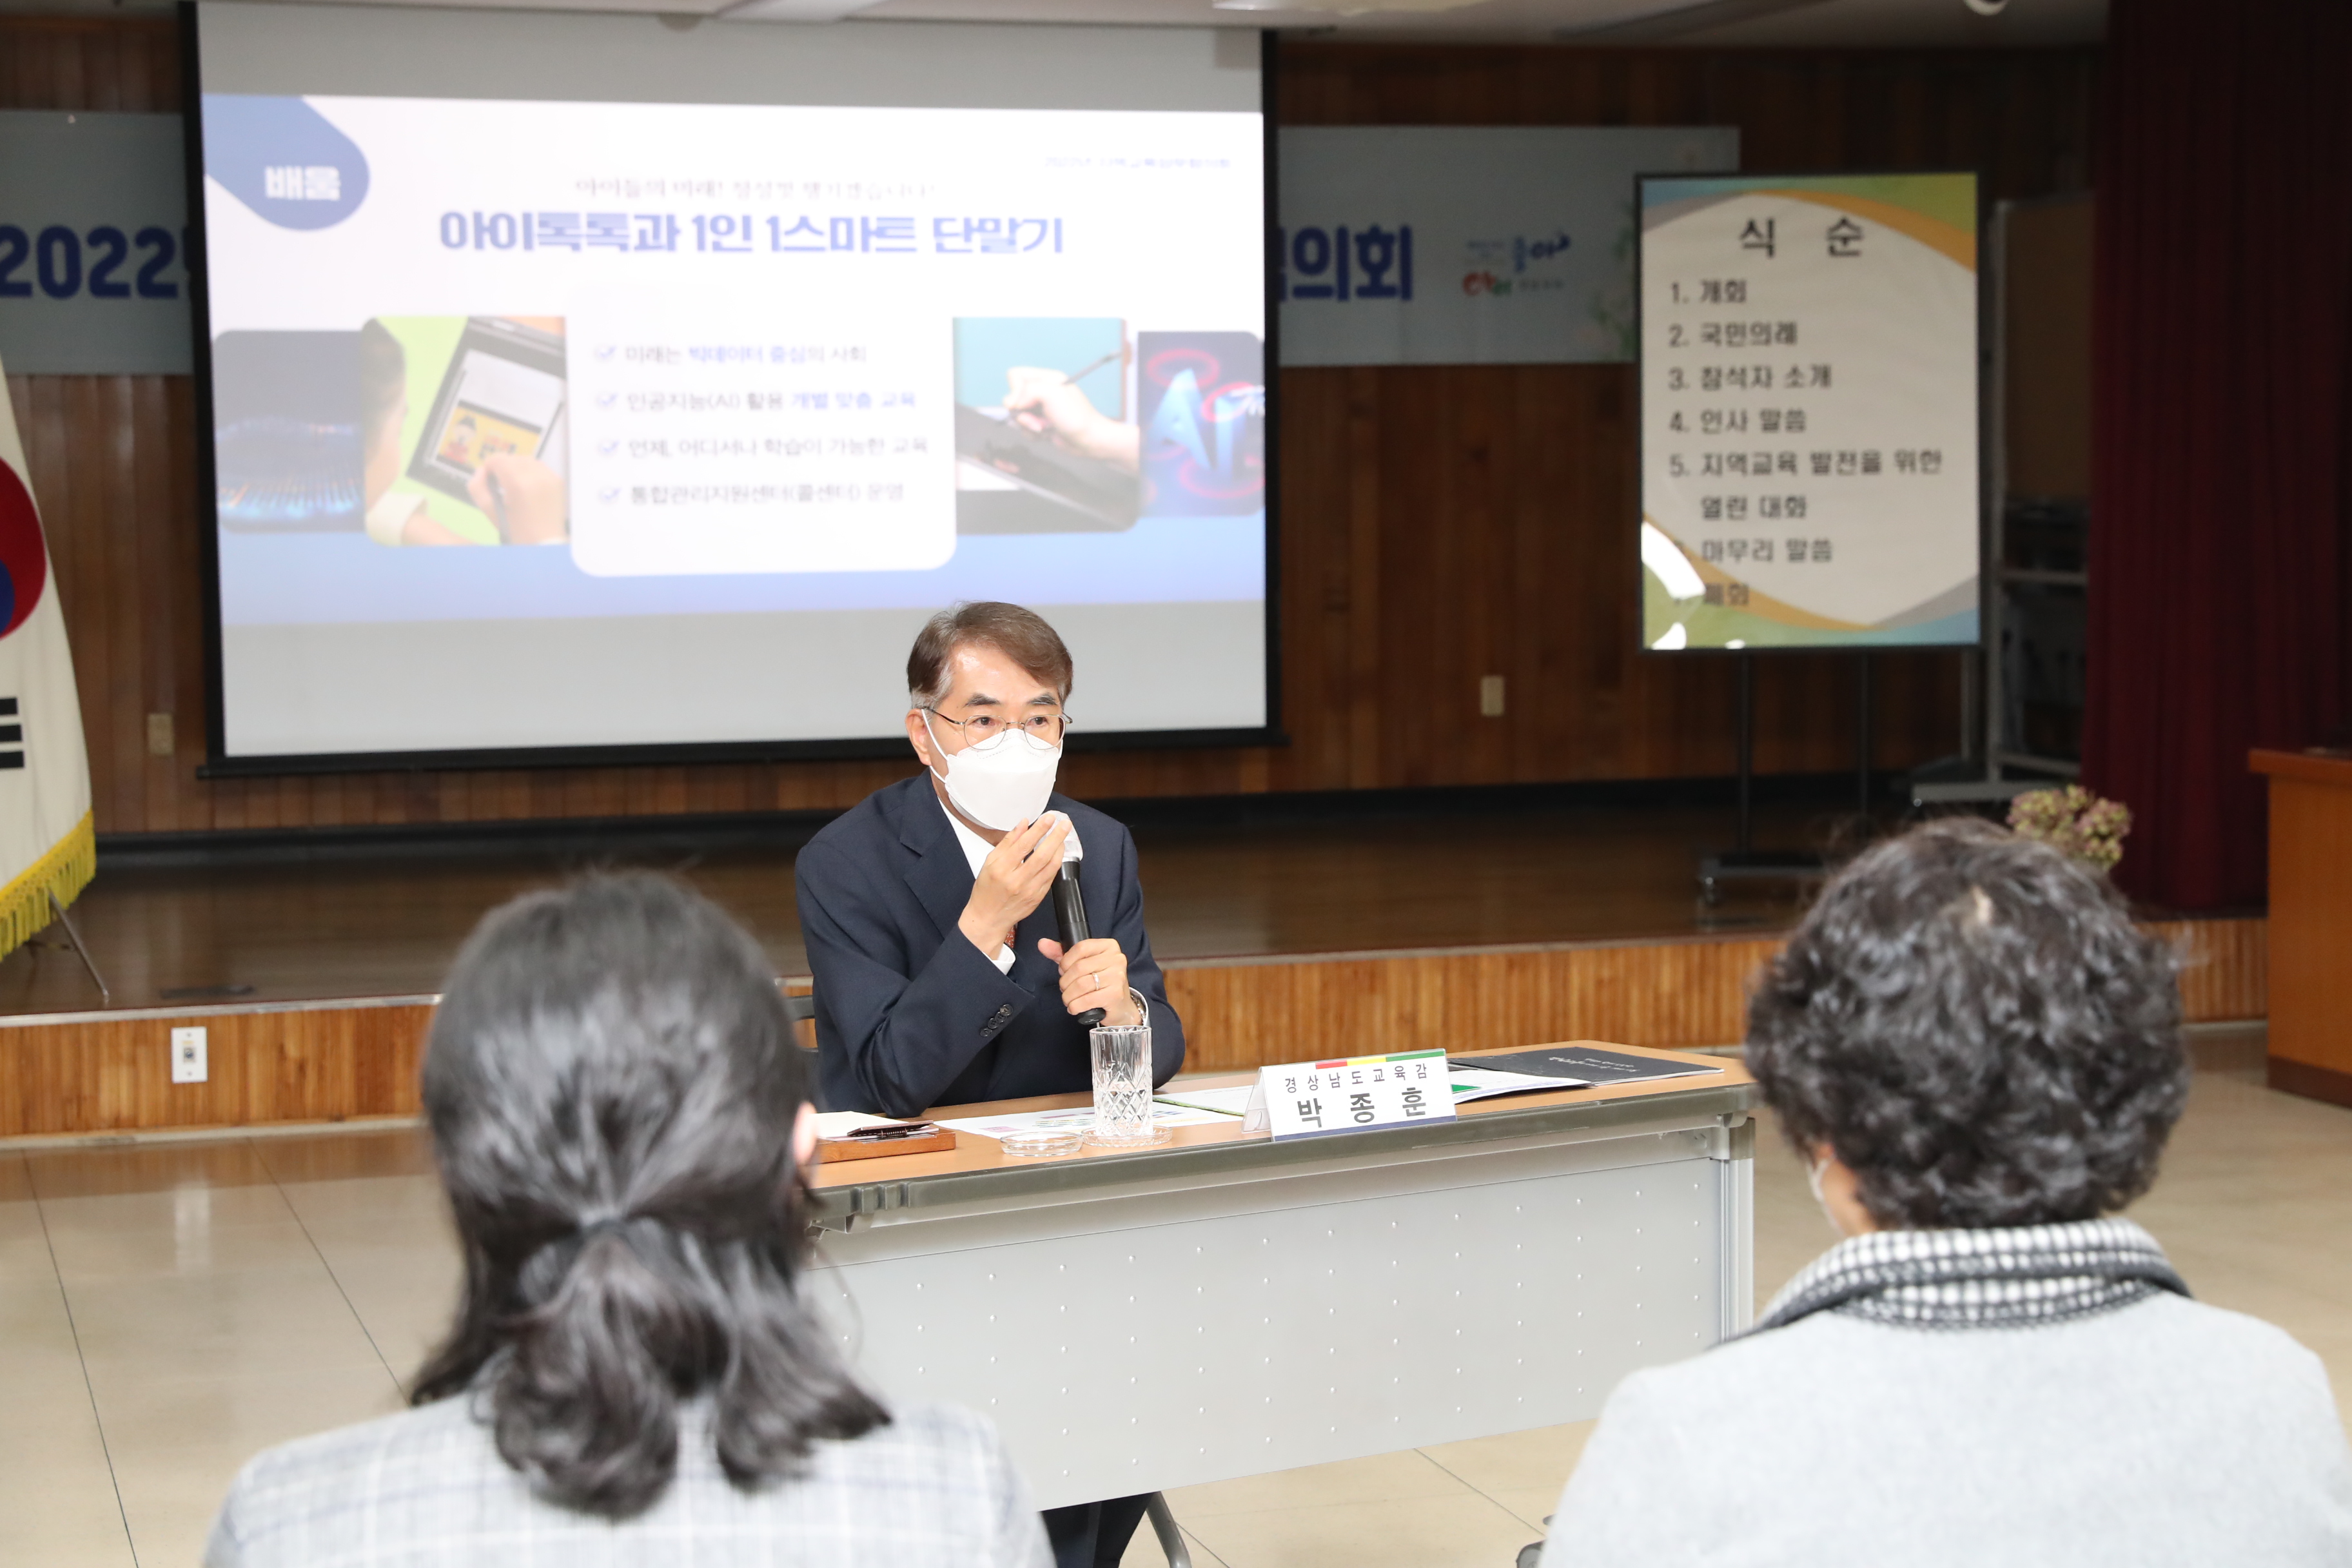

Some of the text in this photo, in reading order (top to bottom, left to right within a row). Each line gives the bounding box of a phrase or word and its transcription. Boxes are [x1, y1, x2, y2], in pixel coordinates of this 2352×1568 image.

[692, 212, 754, 253] 1인
[765, 214, 917, 253] 1스마트
[933, 216, 1063, 254] 단말기
[1670, 279, 1747, 304] 1. 개회
[1669, 321, 1798, 349] 2. 국민의례
[624, 345, 867, 364] 미래는 빅데이터 중심의 사회
[1669, 364, 1832, 391] 3. 참석자 소개
[880, 391, 917, 409] 교육
[1669, 408, 1807, 435] 4. 인사 말씀
[679, 438, 758, 458] 어디서나
[829, 436, 885, 456] 가능한
[892, 436, 928, 454] 교육
[1669, 449, 1943, 477] 5. 지역교육 발전을 위한
[1700, 494, 1807, 521] 열린 대화
[1701, 538, 1774, 564] 마무리
[1785, 537, 1833, 564] 말씀
[1284, 1063, 1427, 1094] 경상남도교육감
